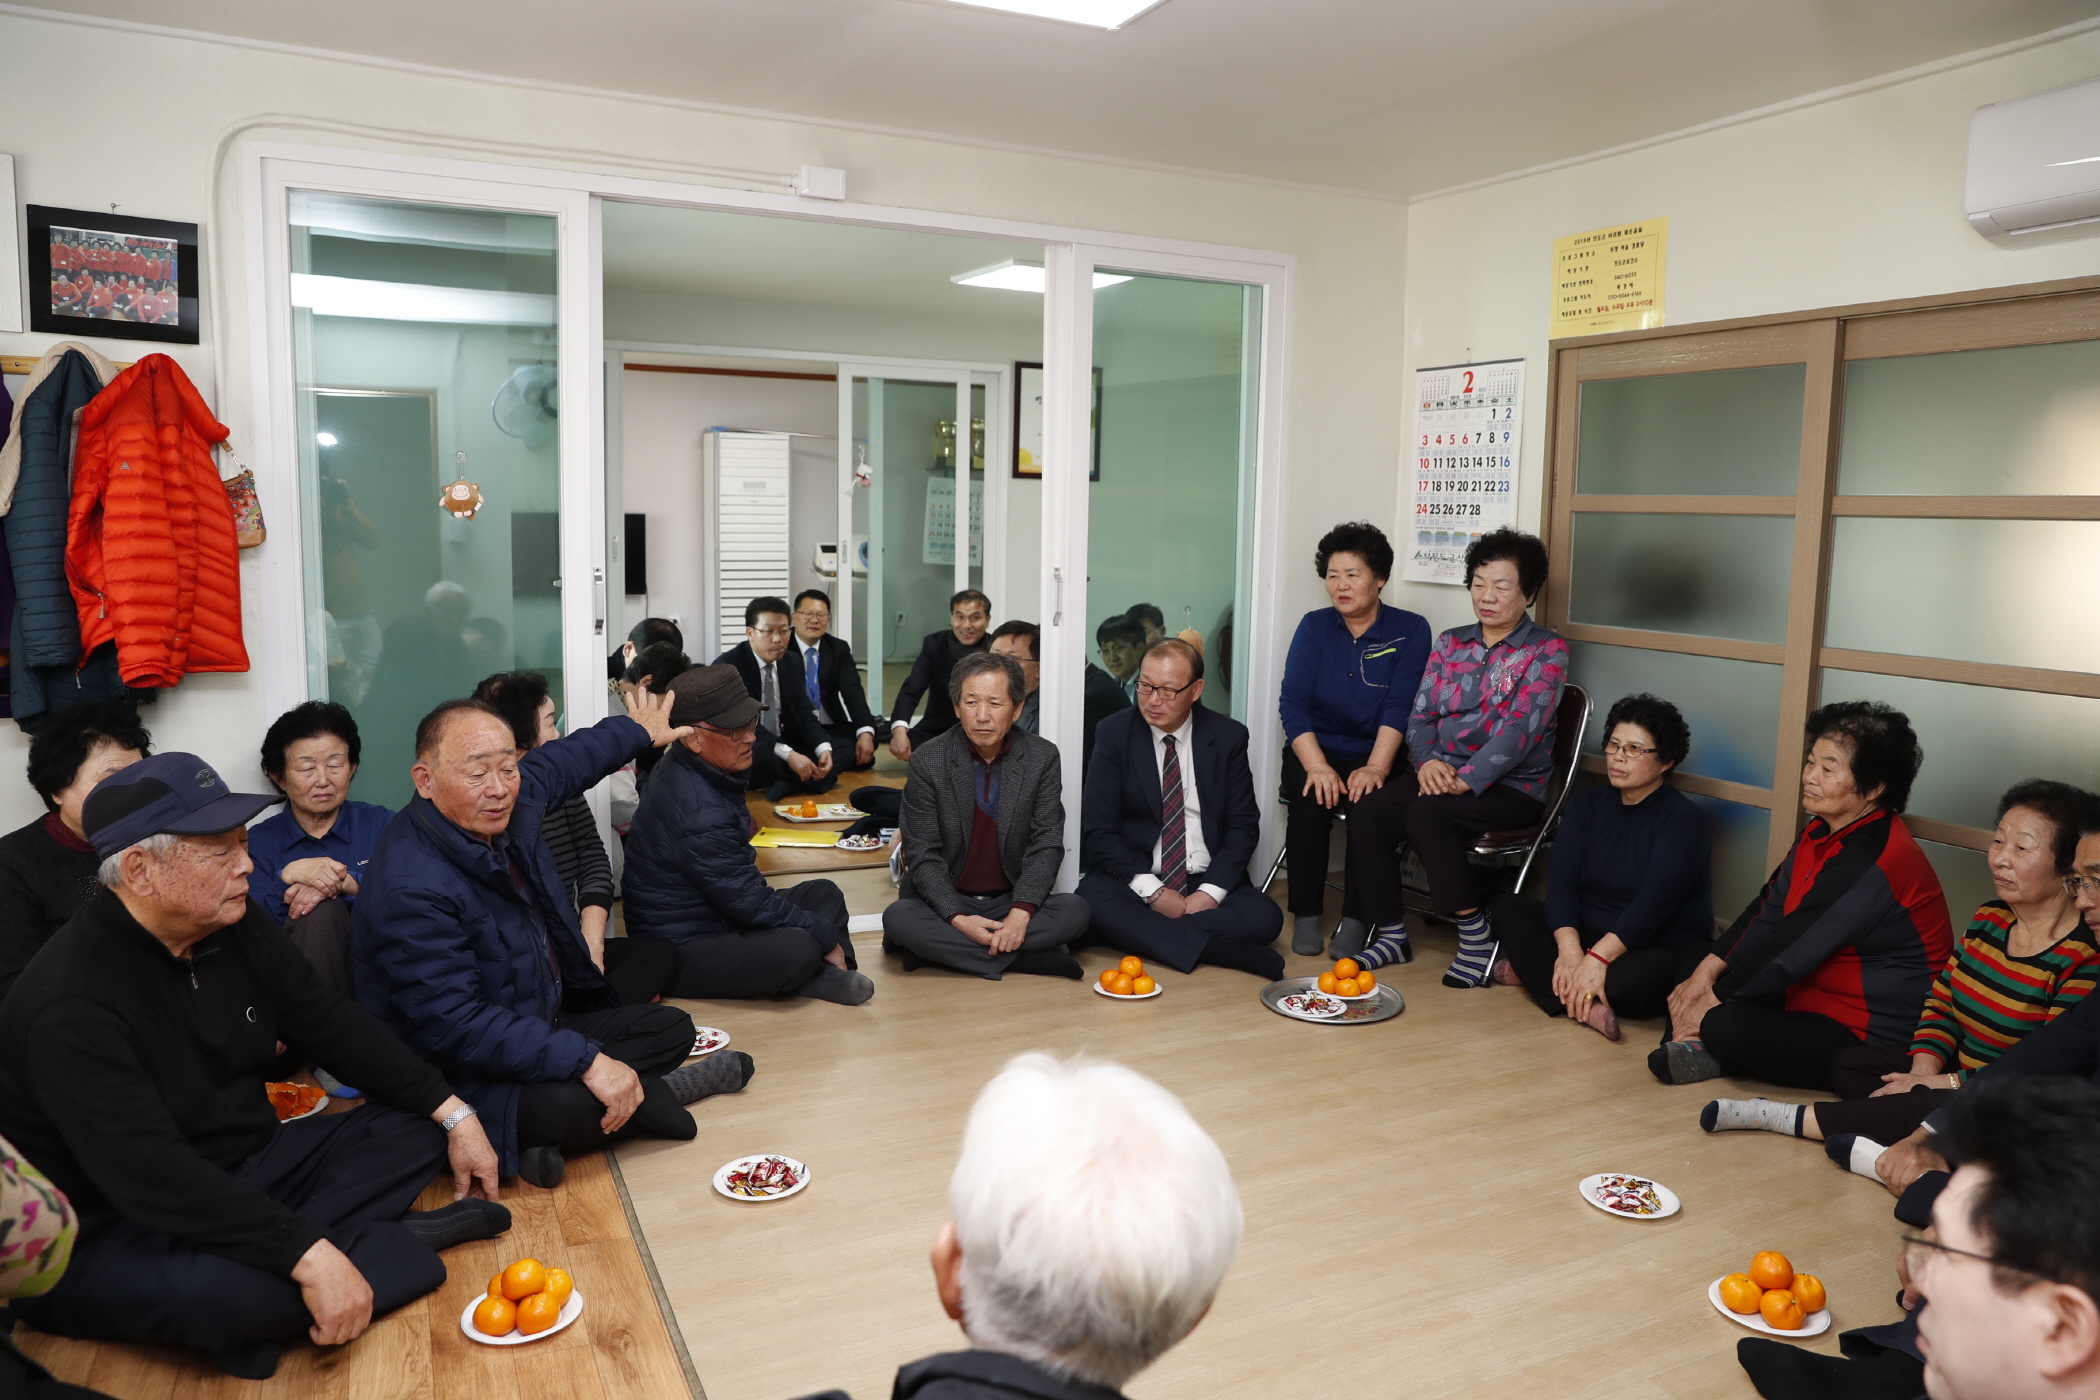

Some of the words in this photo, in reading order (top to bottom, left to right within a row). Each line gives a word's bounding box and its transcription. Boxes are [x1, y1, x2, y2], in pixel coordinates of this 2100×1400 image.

[1463, 371, 1474, 393] 2
[1491, 408, 1496, 419] 1
[1505, 407, 1512, 419] 2
[1422, 435, 1428, 446] 3
[1436, 434, 1442, 445] 4
[1449, 434, 1455, 445] 5
[1462, 433, 1468, 444] 6
[1476, 432, 1482, 444] 7
[1489, 432, 1495, 443] 8
[1503, 431, 1510, 443] 9
[1419, 458, 1429, 469] 10
[1433, 457, 1443, 469] 11
[1446, 457, 1456, 469] 12
[1459, 457, 1469, 468] 13
[1472, 457, 1483, 468] 14
[1486, 456, 1496, 468] 15
[1499, 456, 1510, 468] 16
[1418, 480, 1429, 492] 17
[1431, 480, 1442, 492] 18
[1444, 480, 1455, 492] 19
[1457, 480, 1469, 492] 20
[1471, 480, 1482, 492] 21
[1484, 480, 1496, 492] 22
[1498, 480, 1510, 492] 23
[1416, 503, 1428, 514] 24
[1429, 503, 1441, 515] 25
[1442, 503, 1454, 515] 26
[1455, 504, 1468, 515] 27
[1469, 504, 1481, 516] 28
